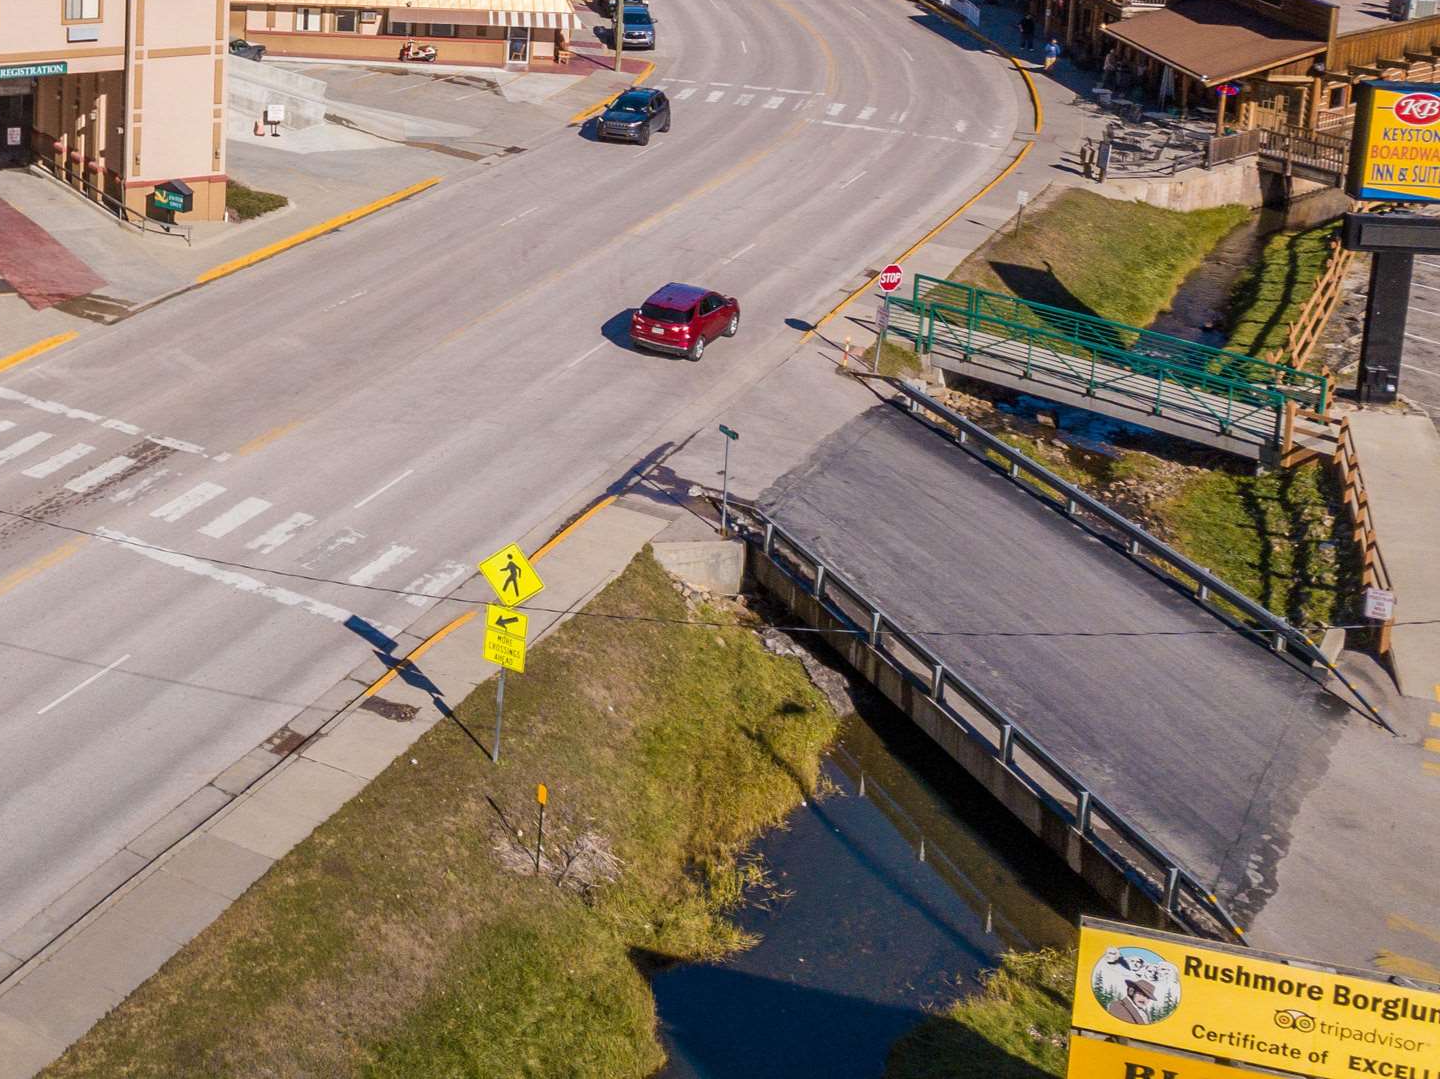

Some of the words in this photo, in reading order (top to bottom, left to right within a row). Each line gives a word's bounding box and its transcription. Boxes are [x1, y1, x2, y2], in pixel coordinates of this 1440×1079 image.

[0, 64, 64, 79] REGISTRATION
[1401, 99, 1439, 119] KB
[1371, 163, 1395, 181] INN
[1398, 168, 1409, 182] &
[880, 273, 901, 283] STOP
[488, 641, 521, 660] CROSSINGS
[498, 635, 512, 647] MORE
[494, 653, 513, 666] AHEAD
[1184, 955, 1324, 1001] Rushmore
[1191, 1024, 1302, 1060] Certificate
[1308, 1049, 1330, 1065] of
[1319, 1021, 1426, 1053] tripadvisor
